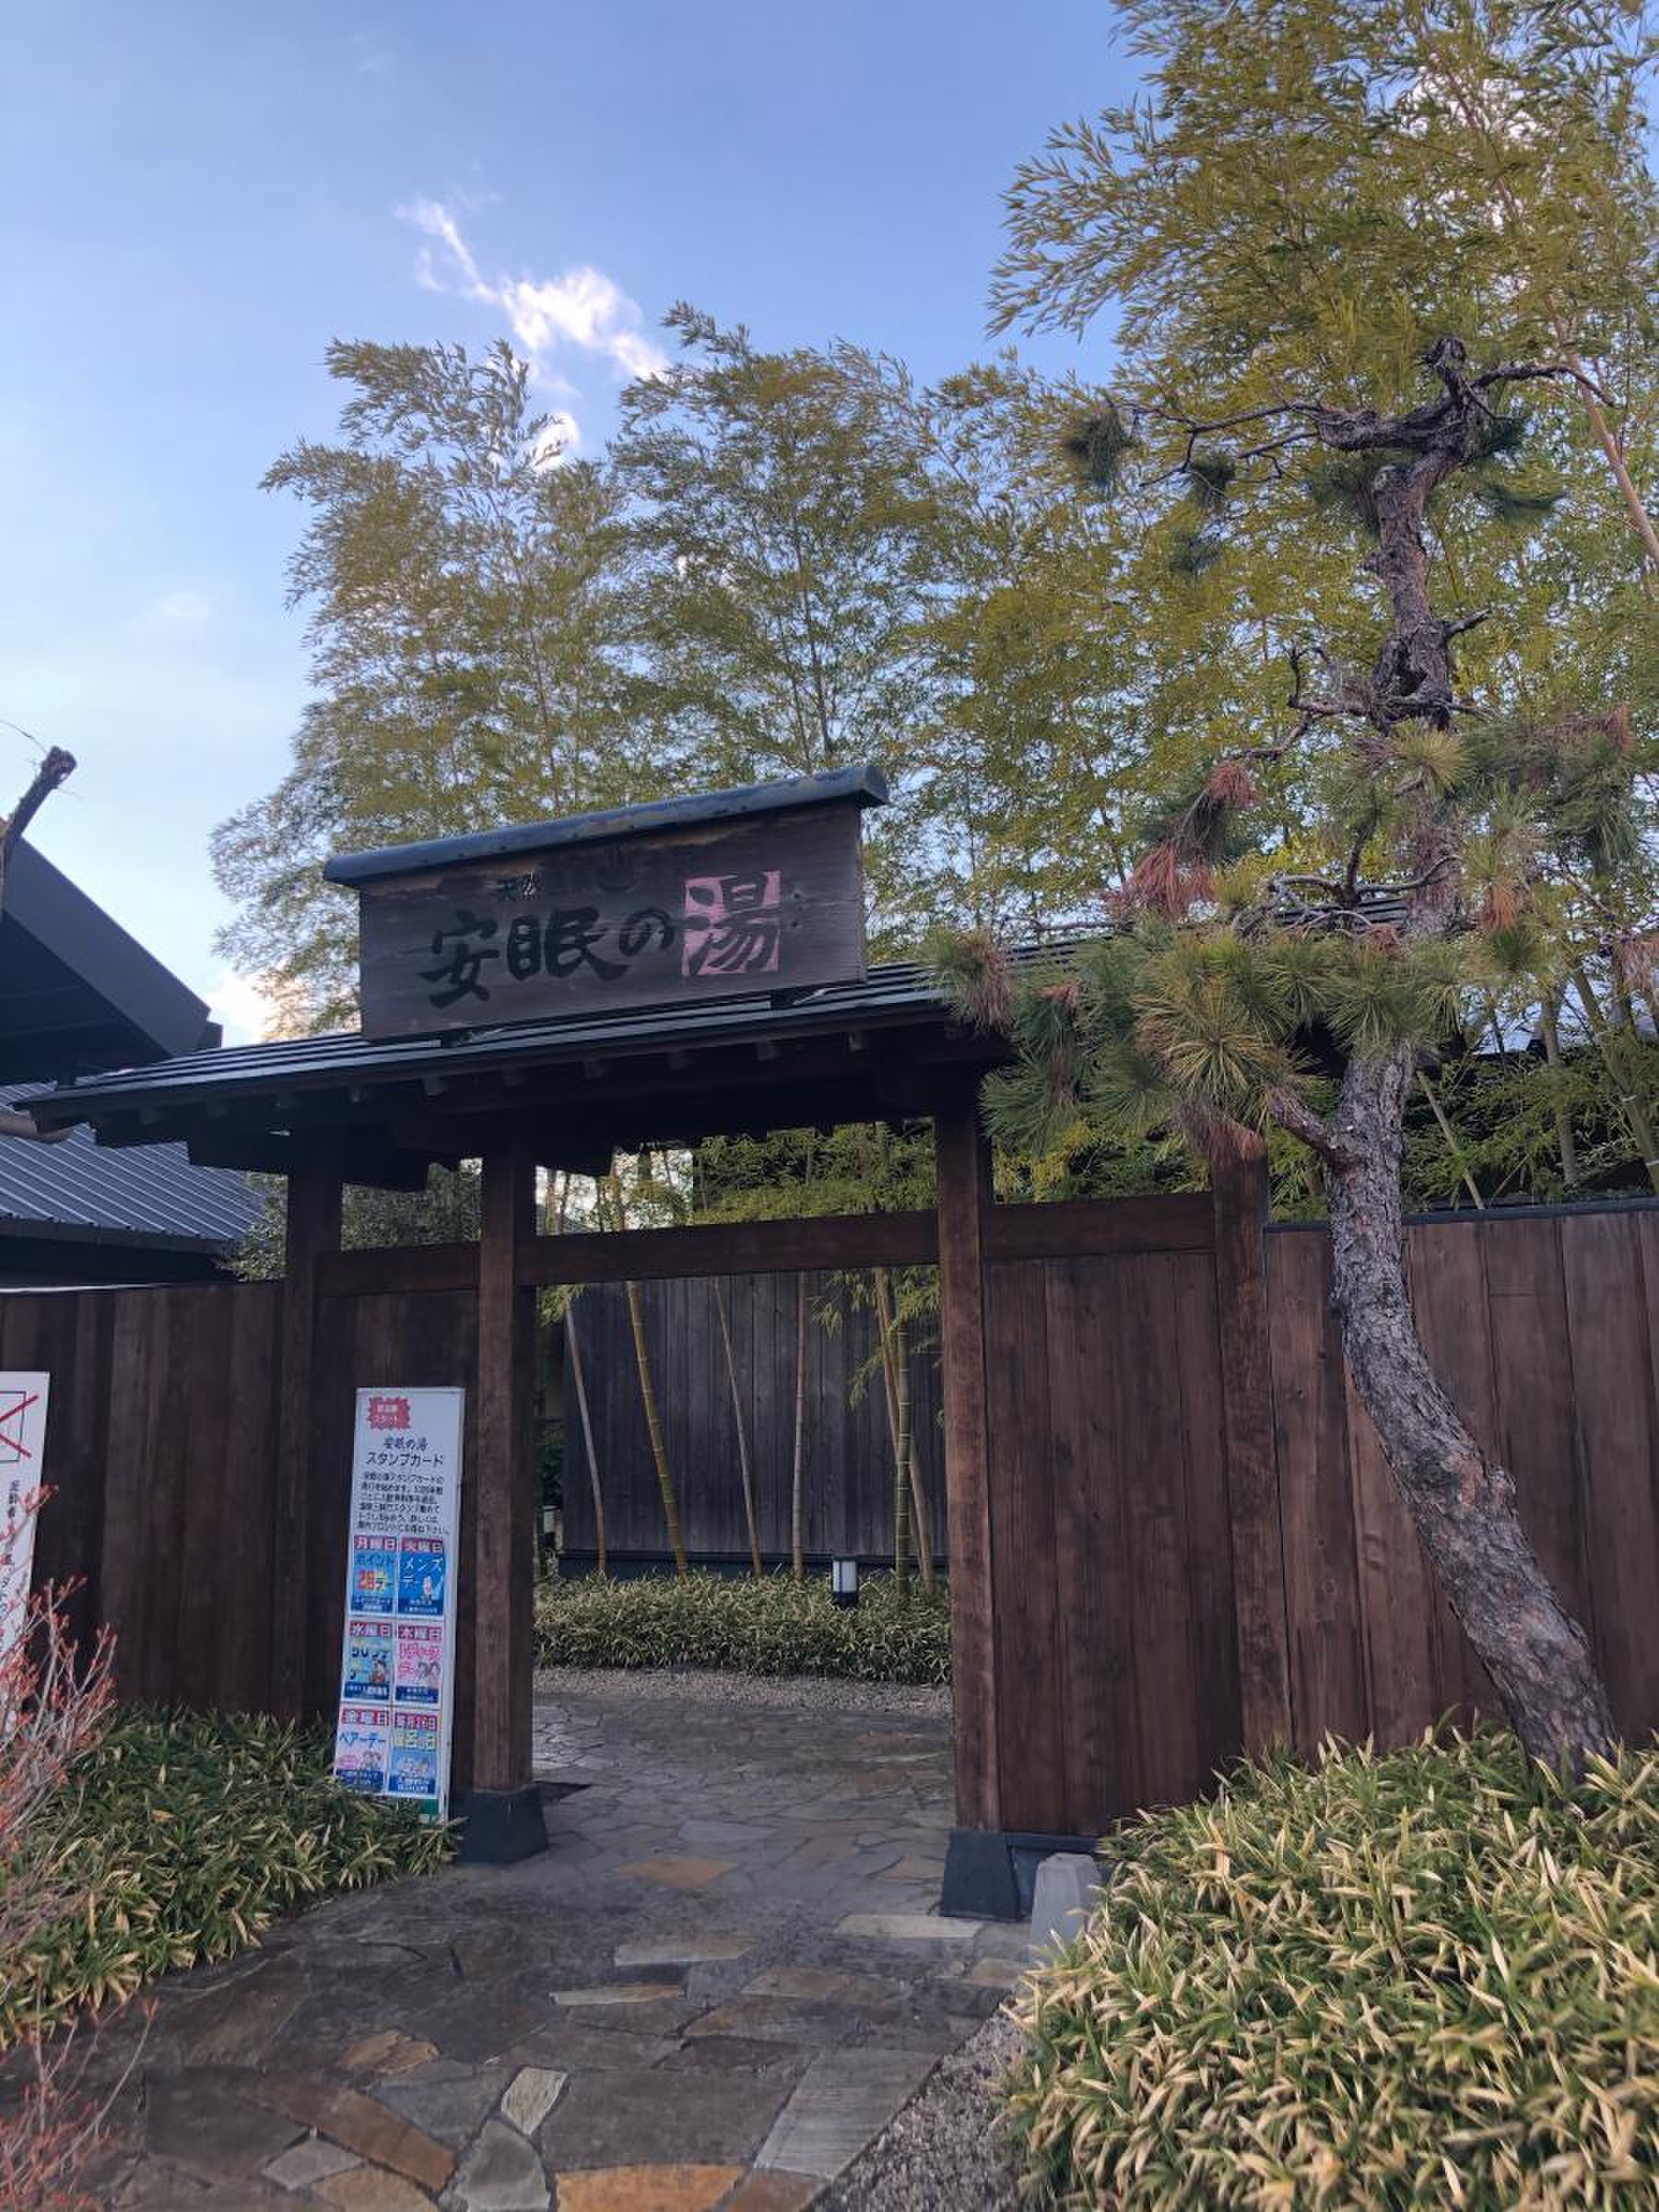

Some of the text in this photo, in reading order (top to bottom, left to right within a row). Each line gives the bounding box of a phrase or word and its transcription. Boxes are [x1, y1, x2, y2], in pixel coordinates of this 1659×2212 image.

[418, 871, 780, 1008] 安眠の湯
[366, 1452, 443, 1467] スタンプカード
[357, 1535, 395, 1549] 月曜日
[404, 1540, 442, 1553] 火曜日
[404, 1557, 442, 1571] メンズ
[351, 1623, 391, 1636] 水曜日
[399, 1627, 441, 1640] 木曜日
[343, 1711, 388, 1725] 金曜日
